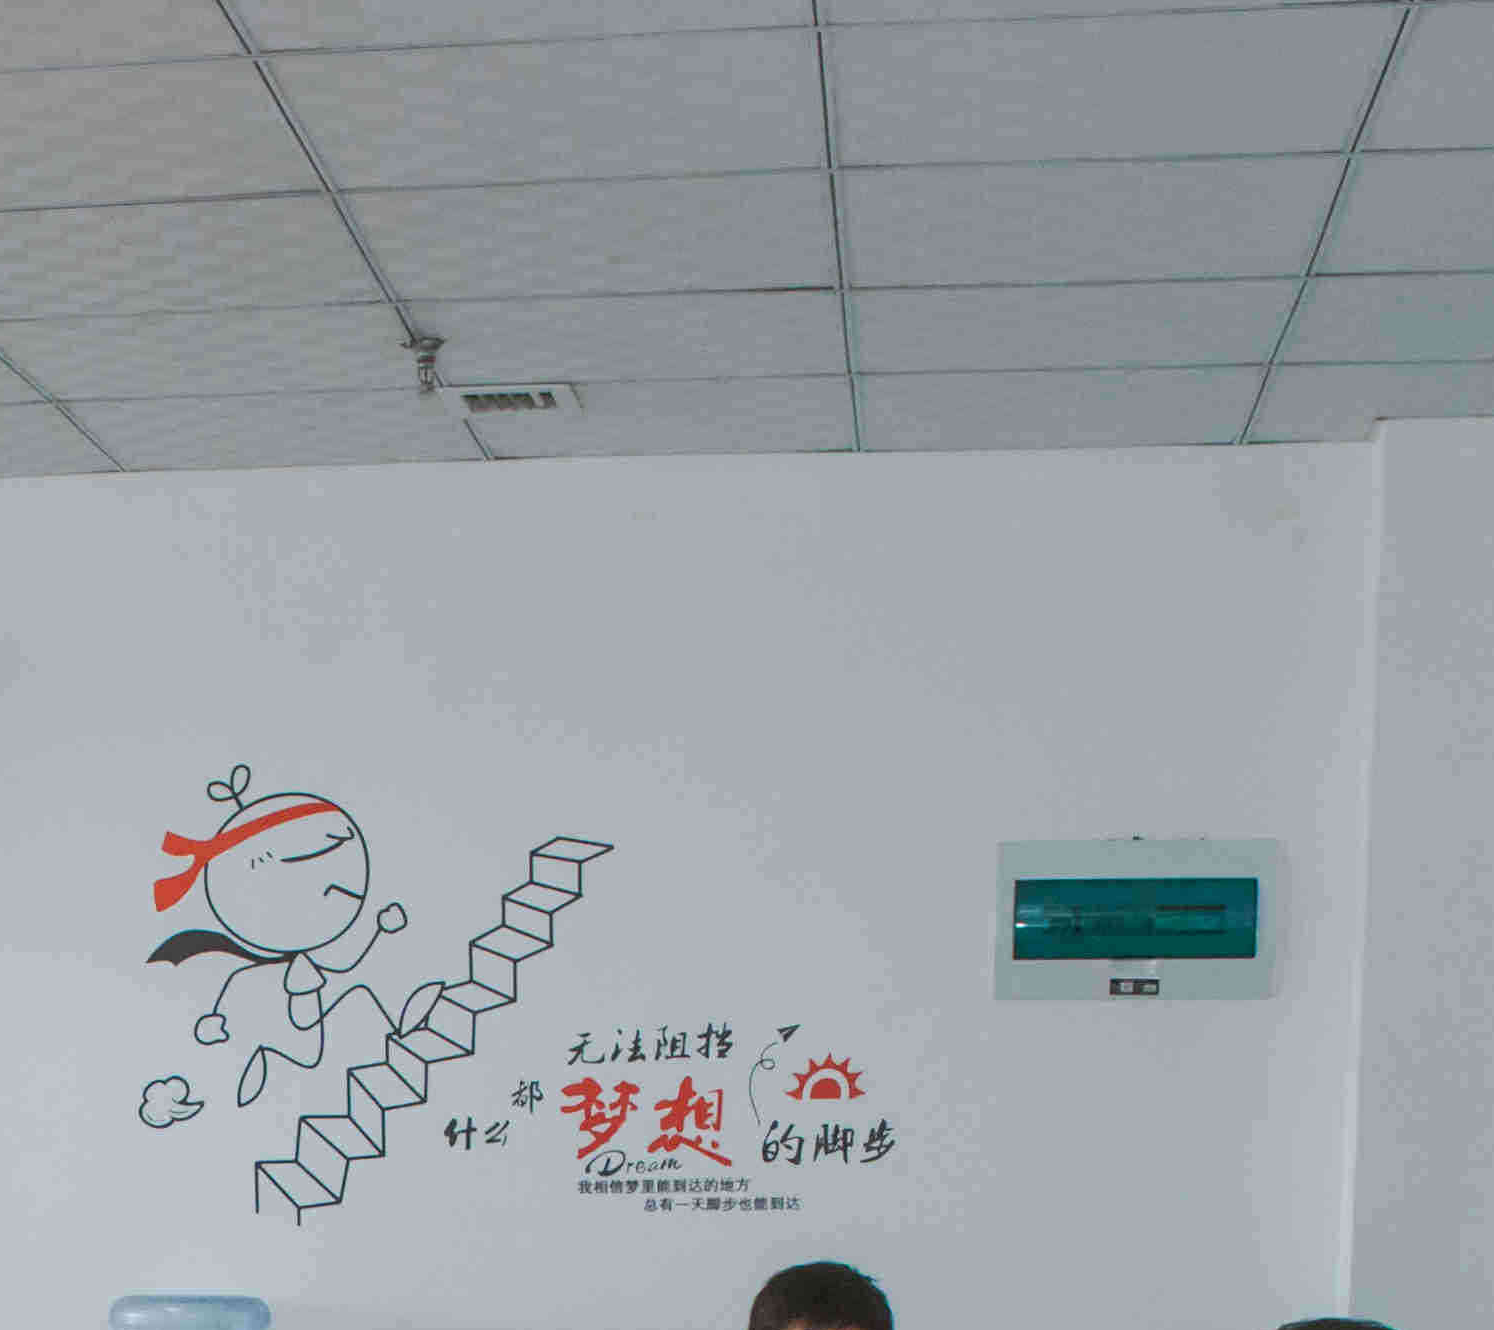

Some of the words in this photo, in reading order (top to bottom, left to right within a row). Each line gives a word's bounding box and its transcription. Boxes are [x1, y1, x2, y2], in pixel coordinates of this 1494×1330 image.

[567, 1021, 733, 1065] 无法阻挡
[443, 1115, 509, 1150] 什么
[560, 1075, 732, 1167] 梦想
[762, 1118, 897, 1165] 的脚步
[585, 1150, 683, 1177] Dream
